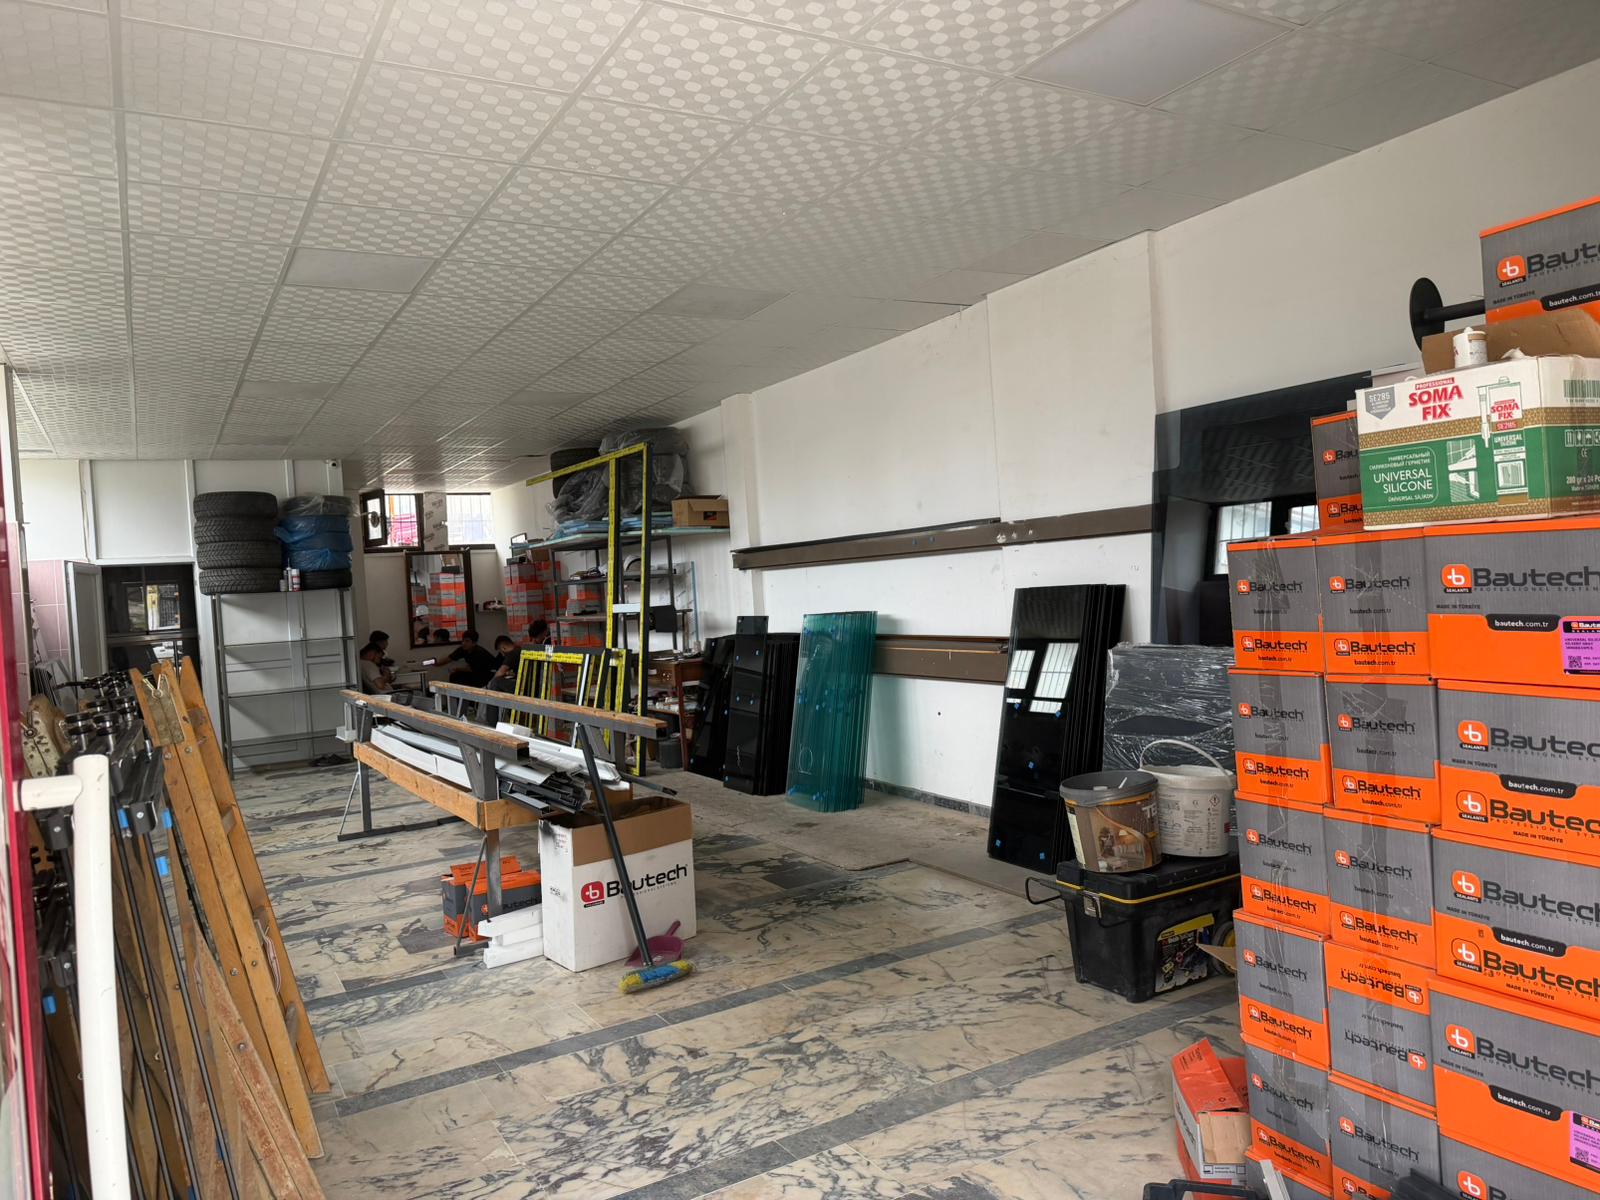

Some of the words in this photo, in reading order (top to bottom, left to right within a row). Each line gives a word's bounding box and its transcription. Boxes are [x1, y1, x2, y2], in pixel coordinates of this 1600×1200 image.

[1527, 242, 1600, 274] Baut
[1409, 385, 1464, 407] SOMA
[1423, 404, 1450, 421] FIX
[1491, 403, 1520, 414] SOMA
[1498, 412, 1513, 420] FIX
[1336, 448, 1360, 460] Bau
[1373, 468, 1432, 484] UNIVERSAL
[1383, 480, 1433, 494] SILICONE
[1341, 503, 1363, 513] Bau
[1250, 581, 1303, 592] Bautech
[1345, 576, 1410, 590] Bautech
[1473, 566, 1600, 587] Bautech
[1494, 620, 1549, 628] bautech.com.tr
[1254, 639, 1307, 651] Bautech
[1350, 641, 1416, 653] Bautech
[1251, 706, 1304, 720] Bautech
[1352, 717, 1415, 732] Bautech
[1490, 727, 1600, 758] Bautec
[1256, 762, 1309, 778] Bautech
[1357, 780, 1421, 798] Bautech
[1508, 780, 1564, 794] bautech.com.tr
[1490, 799, 1600, 835] Bautec
[1259, 834, 1312, 854] Bautech
[1350, 856, 1412, 878] Bautech
[1263, 889, 1316, 912] Bautech
[1483, 880, 1600, 923] Bautec
[1355, 917, 1418, 943] Bautech
[1500, 933, 1555, 953] bautech.com.tr
[1256, 956, 1307, 980] Bautech
[1483, 950, 1600, 997] Bautec
[1341, 968, 1405, 999] Bautech
[1260, 1011, 1312, 1038] Bautech
[1345, 1029, 1408, 1062] Bautech
[1476, 1037, 1600, 1090] Bautech
[1498, 1093, 1551, 1115] bautech.com.tr
[1269, 1136, 1320, 1168] Bautech
[1355, 1126, 1419, 1161] Bautech
